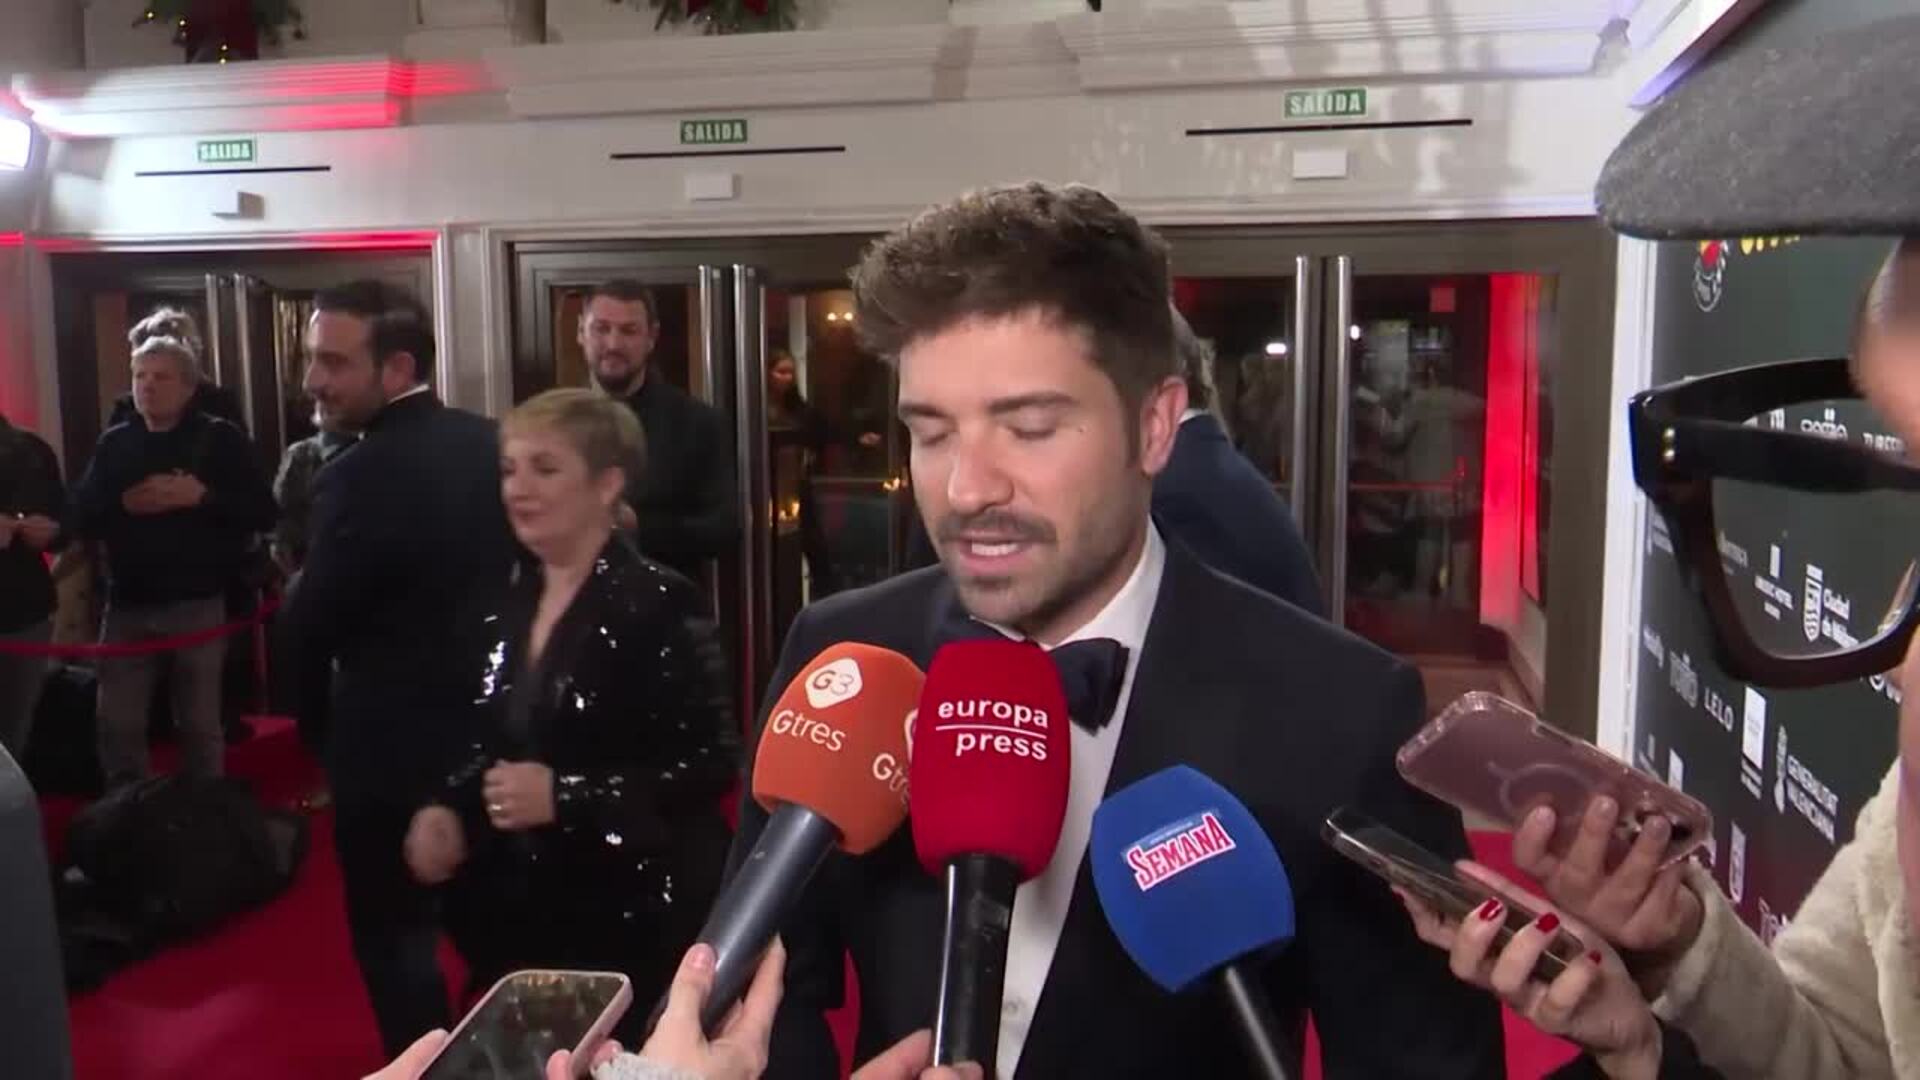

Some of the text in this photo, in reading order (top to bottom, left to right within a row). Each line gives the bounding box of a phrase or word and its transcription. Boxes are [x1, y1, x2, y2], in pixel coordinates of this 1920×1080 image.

[1290, 92, 1362, 115] SALIDA
[684, 122, 744, 141] SALIDA
[201, 142, 251, 159] SALIDA
[812, 669, 855, 696] G3
[937, 699, 1048, 729] europa
[1704, 687, 1734, 732] LELO
[772, 709, 846, 752] Gtres
[955, 733, 1048, 761] press
[1128, 813, 1235, 888] SEMANA
